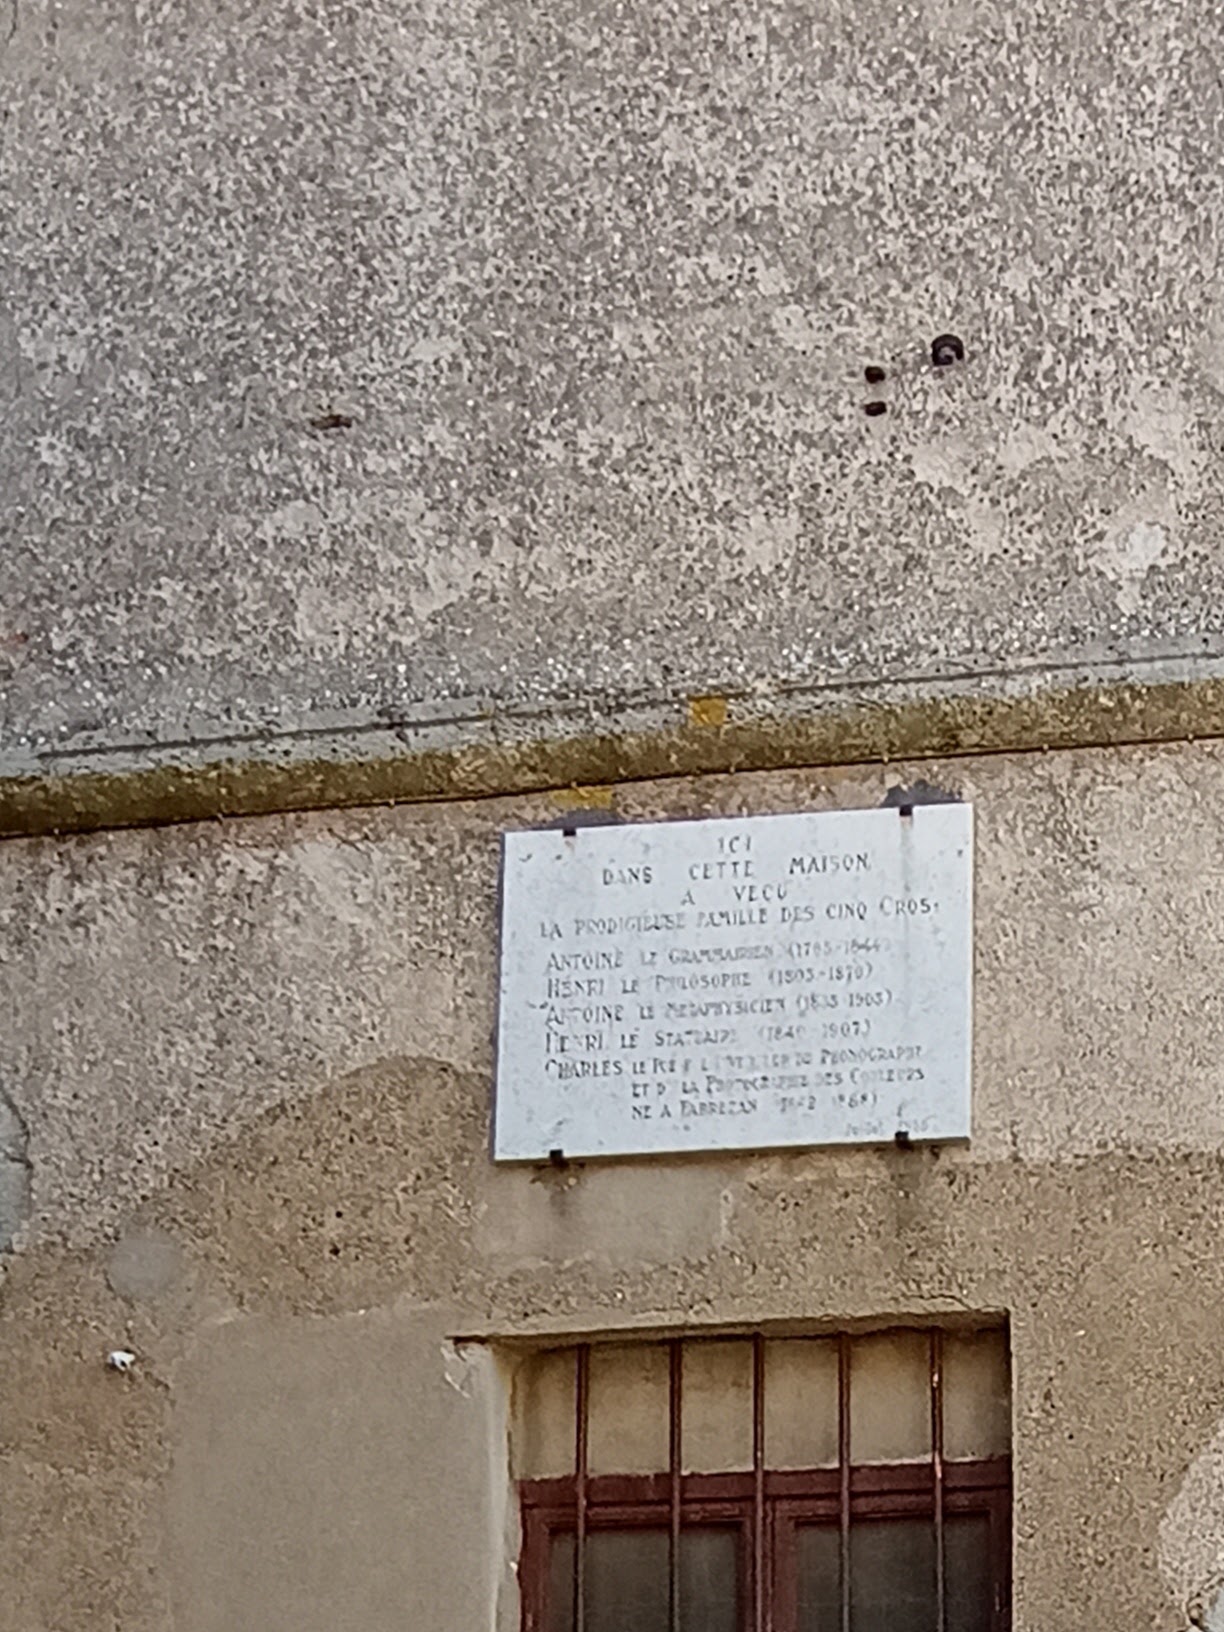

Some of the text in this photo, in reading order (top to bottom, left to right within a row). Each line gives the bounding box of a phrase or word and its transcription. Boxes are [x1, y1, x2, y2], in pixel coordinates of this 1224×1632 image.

[716, 835, 752, 855] ICI
[602, 852, 871, 886] DANS CETTE MAISON
[682, 886, 788, 906] A VECU
[540, 921, 563, 939] LA
[574, 912, 686, 936] PRODIGIEUSE
[695, 907, 768, 928] FAMILLE
[781, 904, 816, 924] DES
[825, 901, 868, 922] CINQ
[546, 947, 623, 972] ANTOINE
[640, 947, 658, 964] LE
[547, 974, 604, 1000] HENRI
[621, 977, 639, 994] LE
[656, 972, 751, 993] PHILOSOPHE
[639, 1003, 655, 1020] LE
[620, 1032, 638, 1050] LE
[545, 1058, 623, 1081] CHARLES
[632, 1060, 648, 1076] LE
[632, 1083, 648, 1099] ET
